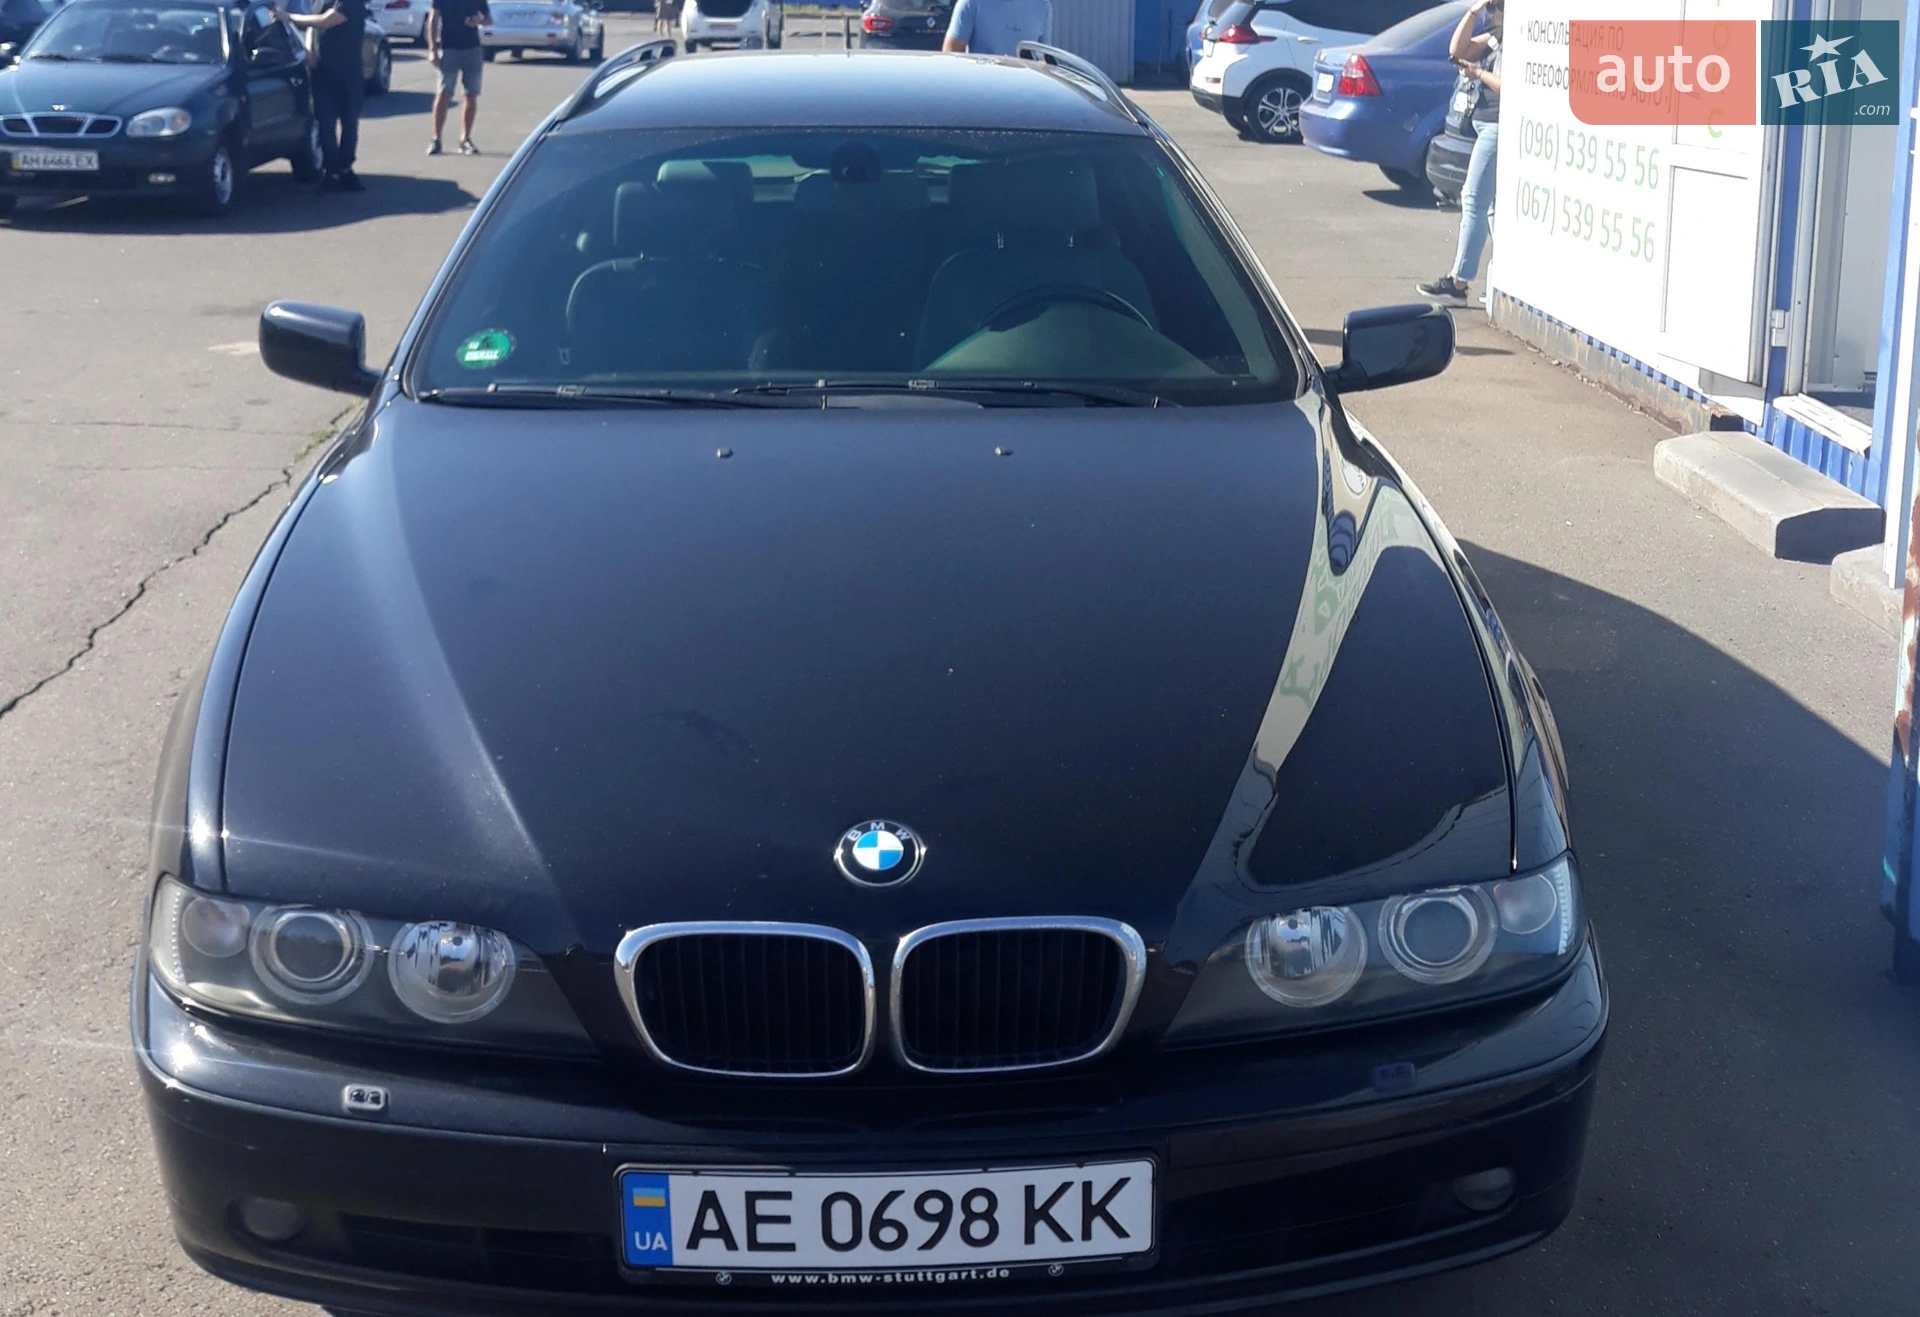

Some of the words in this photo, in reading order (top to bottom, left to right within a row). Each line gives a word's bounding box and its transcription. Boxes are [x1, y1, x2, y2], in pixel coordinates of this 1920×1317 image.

[1527, 20, 1605, 53] КОНСУЛЬТАЦИЯ
[1608, 25, 1624, 51] ПО
[1519, 115, 1560, 172] (096)
[1565, 129, 1598, 174] 539
[1603, 139, 1627, 182] 55
[1634, 145, 1660, 190] 56
[1516, 176, 1556, 236] (067)
[1562, 195, 1594, 241] 539
[1600, 208, 1623, 252] 55
[1630, 216, 1655, 263] 56
[847, 821, 911, 842] BMW
[686, 1190, 797, 1252] AE
[820, 1187, 1000, 1252] 0698
[1023, 1177, 1132, 1246] KK
[635, 1231, 668, 1251] UA
[771, 1267, 1010, 1285] www.bmw-stuttgart.de
